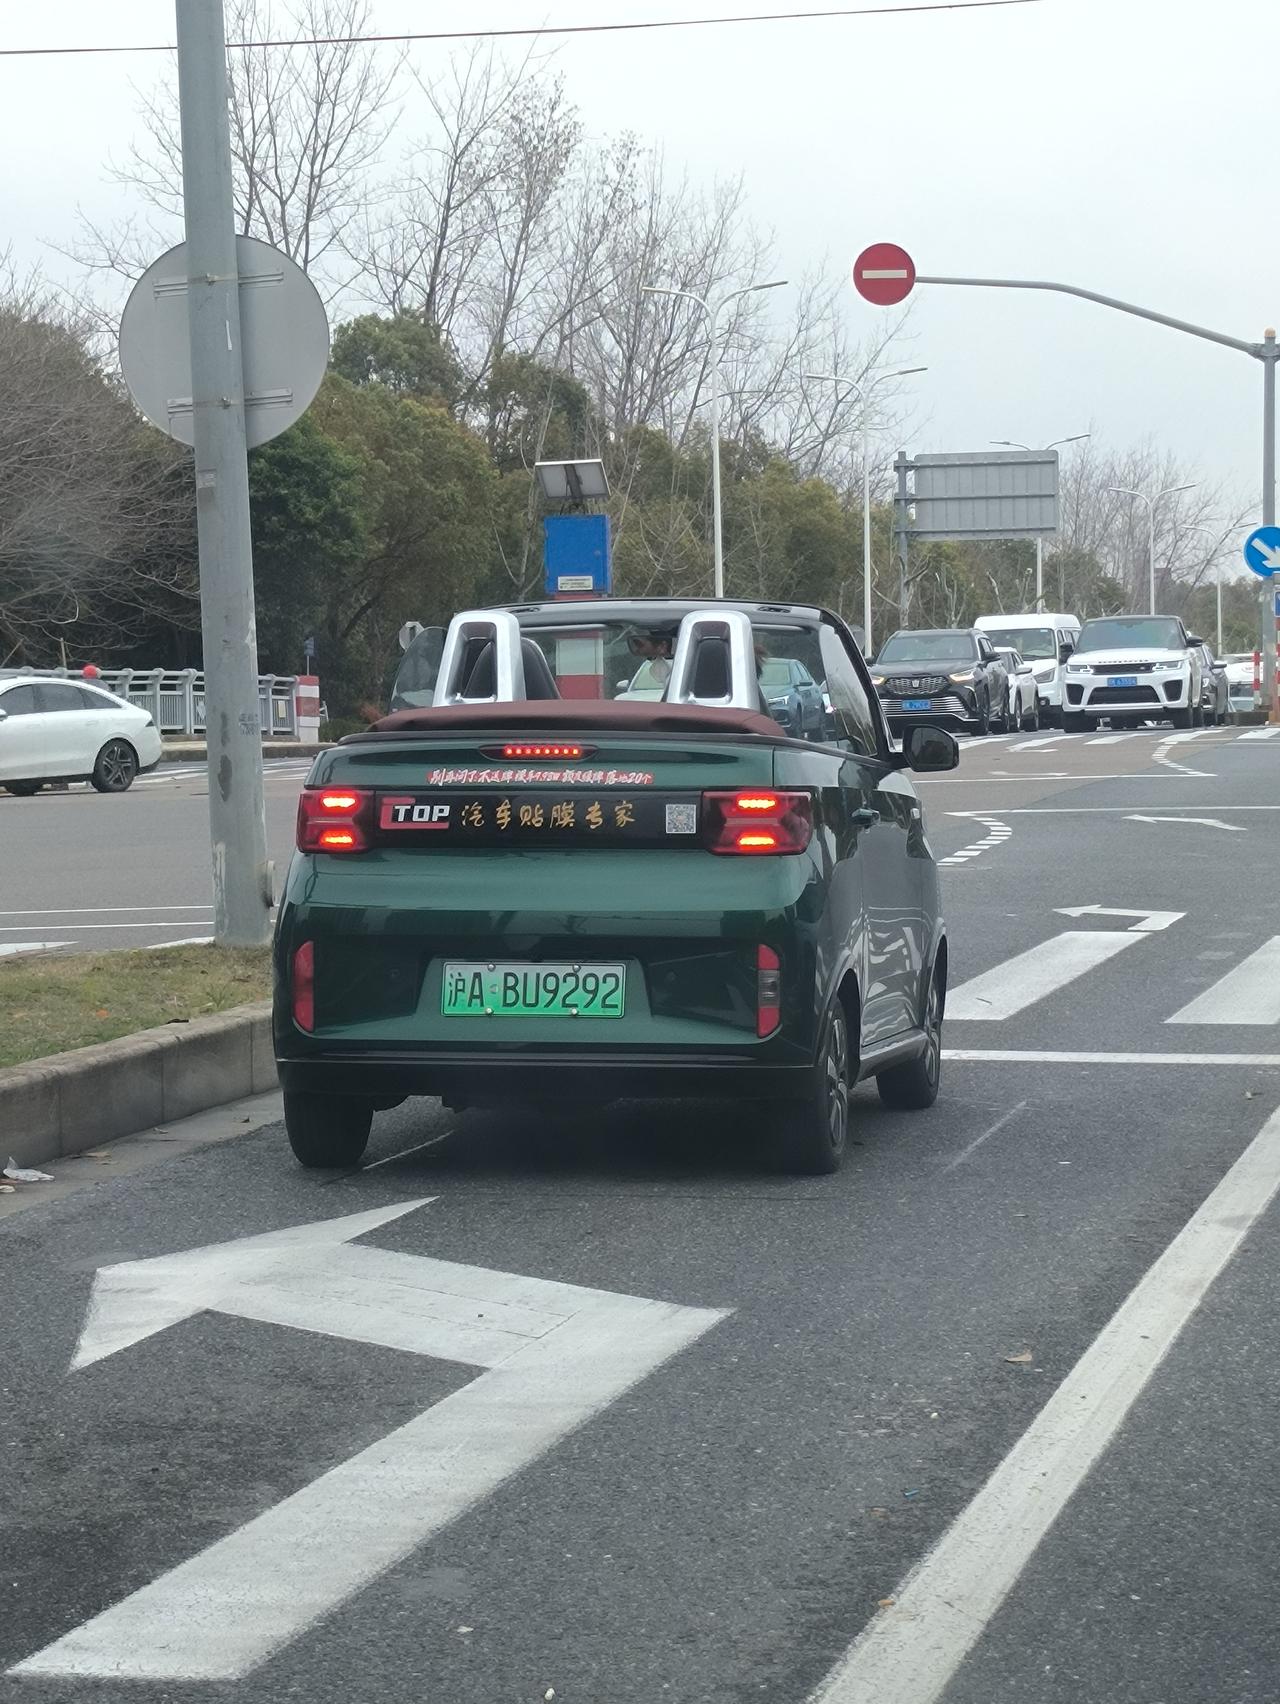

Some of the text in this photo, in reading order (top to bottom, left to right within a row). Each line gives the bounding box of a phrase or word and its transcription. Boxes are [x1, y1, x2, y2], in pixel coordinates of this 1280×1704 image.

[394, 804, 450, 822] TOP
[460, 799, 636, 830] 汽车贴膜专家
